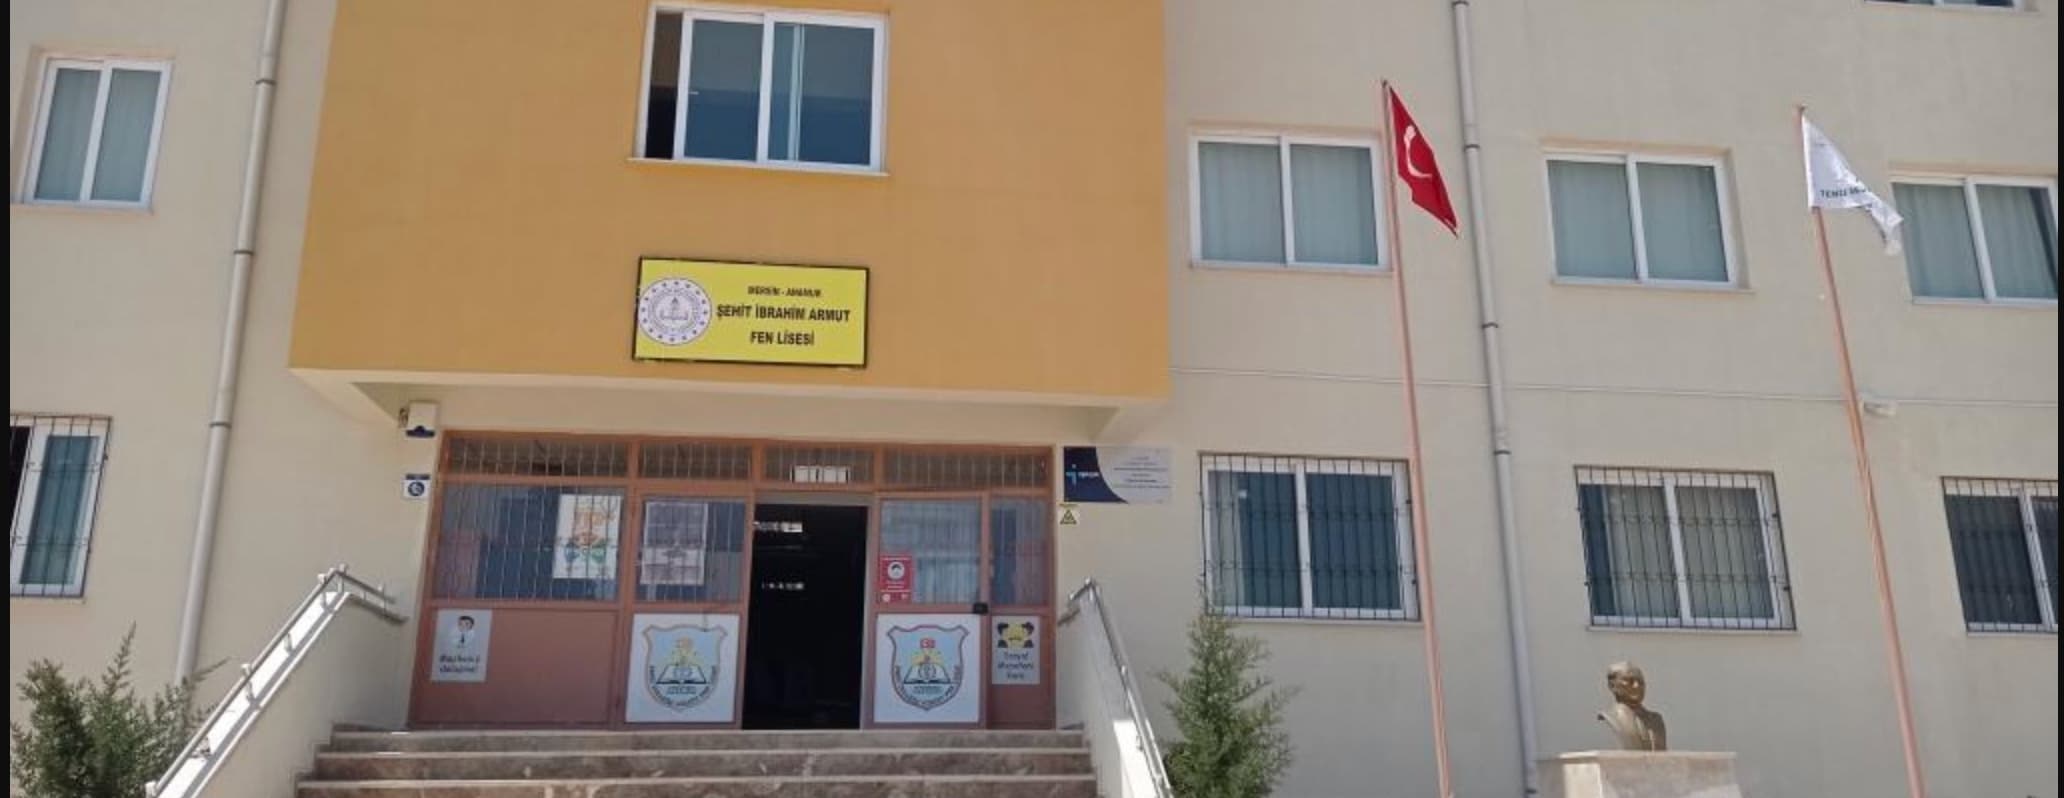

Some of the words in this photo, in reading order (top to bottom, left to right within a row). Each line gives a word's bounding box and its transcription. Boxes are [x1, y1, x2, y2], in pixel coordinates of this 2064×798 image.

[716, 304, 752, 319] ŞEHİT
[755, 304, 805, 319] İBRAHİM
[809, 309, 850, 321] ARMUT
[750, 331, 773, 344] FEN
[777, 330, 815, 345] LİSESİ
